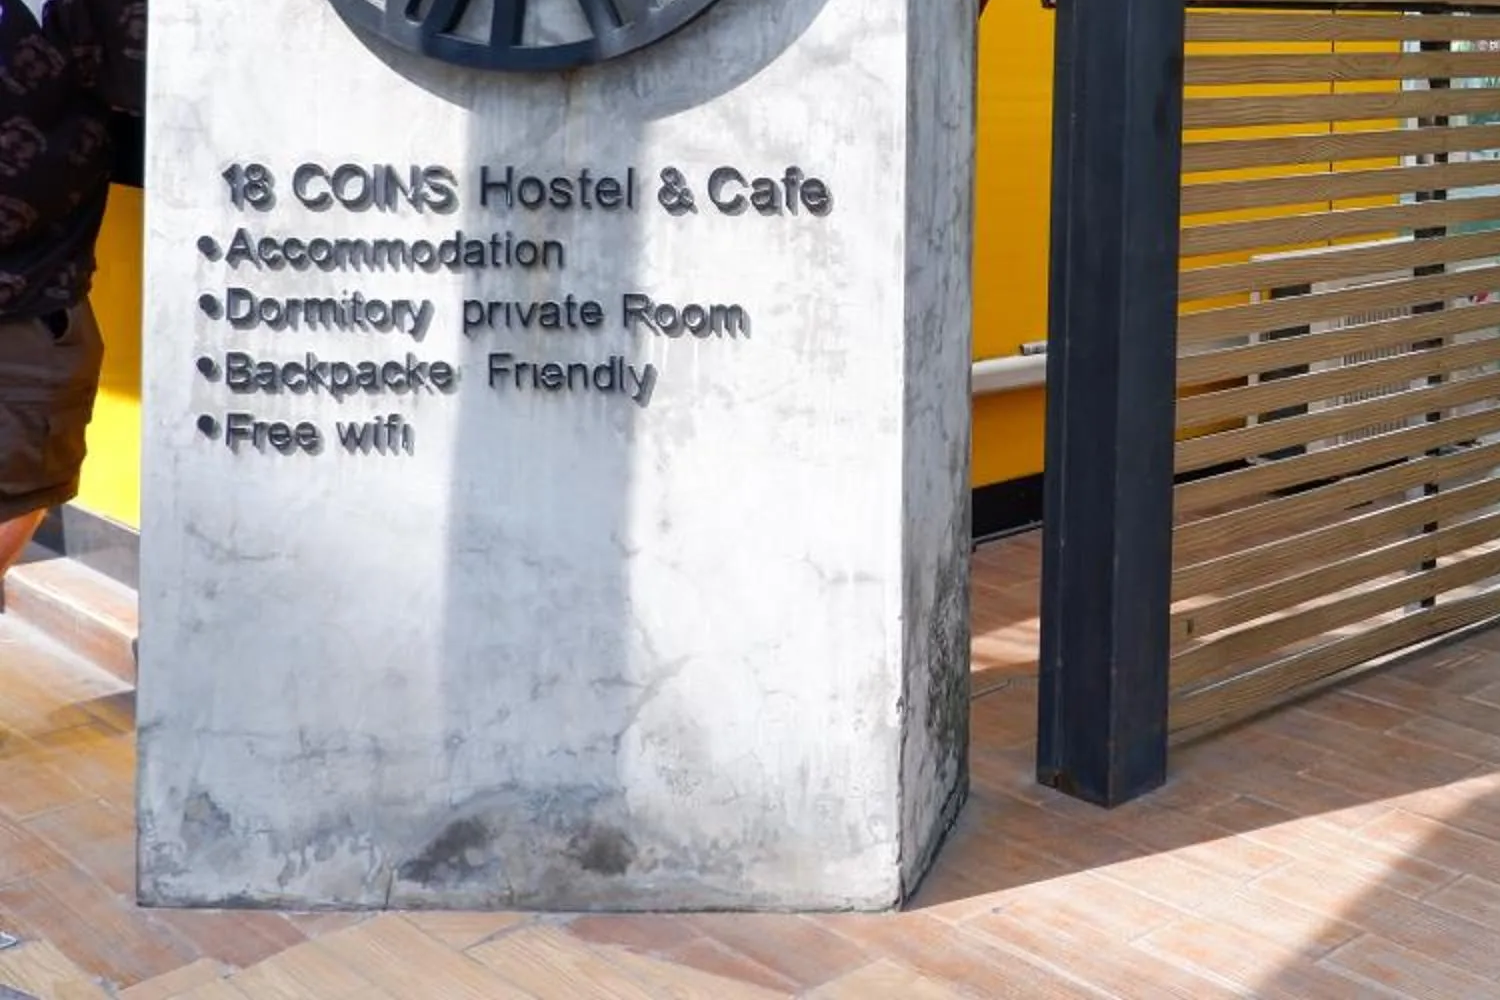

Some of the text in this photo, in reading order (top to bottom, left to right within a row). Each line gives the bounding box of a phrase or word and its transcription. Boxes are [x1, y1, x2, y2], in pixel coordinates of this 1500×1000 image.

[221, 162, 834, 217] 18 COINS Hostel & Cafe
[224, 227, 566, 274] Accommodation
[225, 286, 752, 341] Dormitory private Room
[487, 352, 659, 408] Friendly
[225, 411, 417, 457] Free wifi
